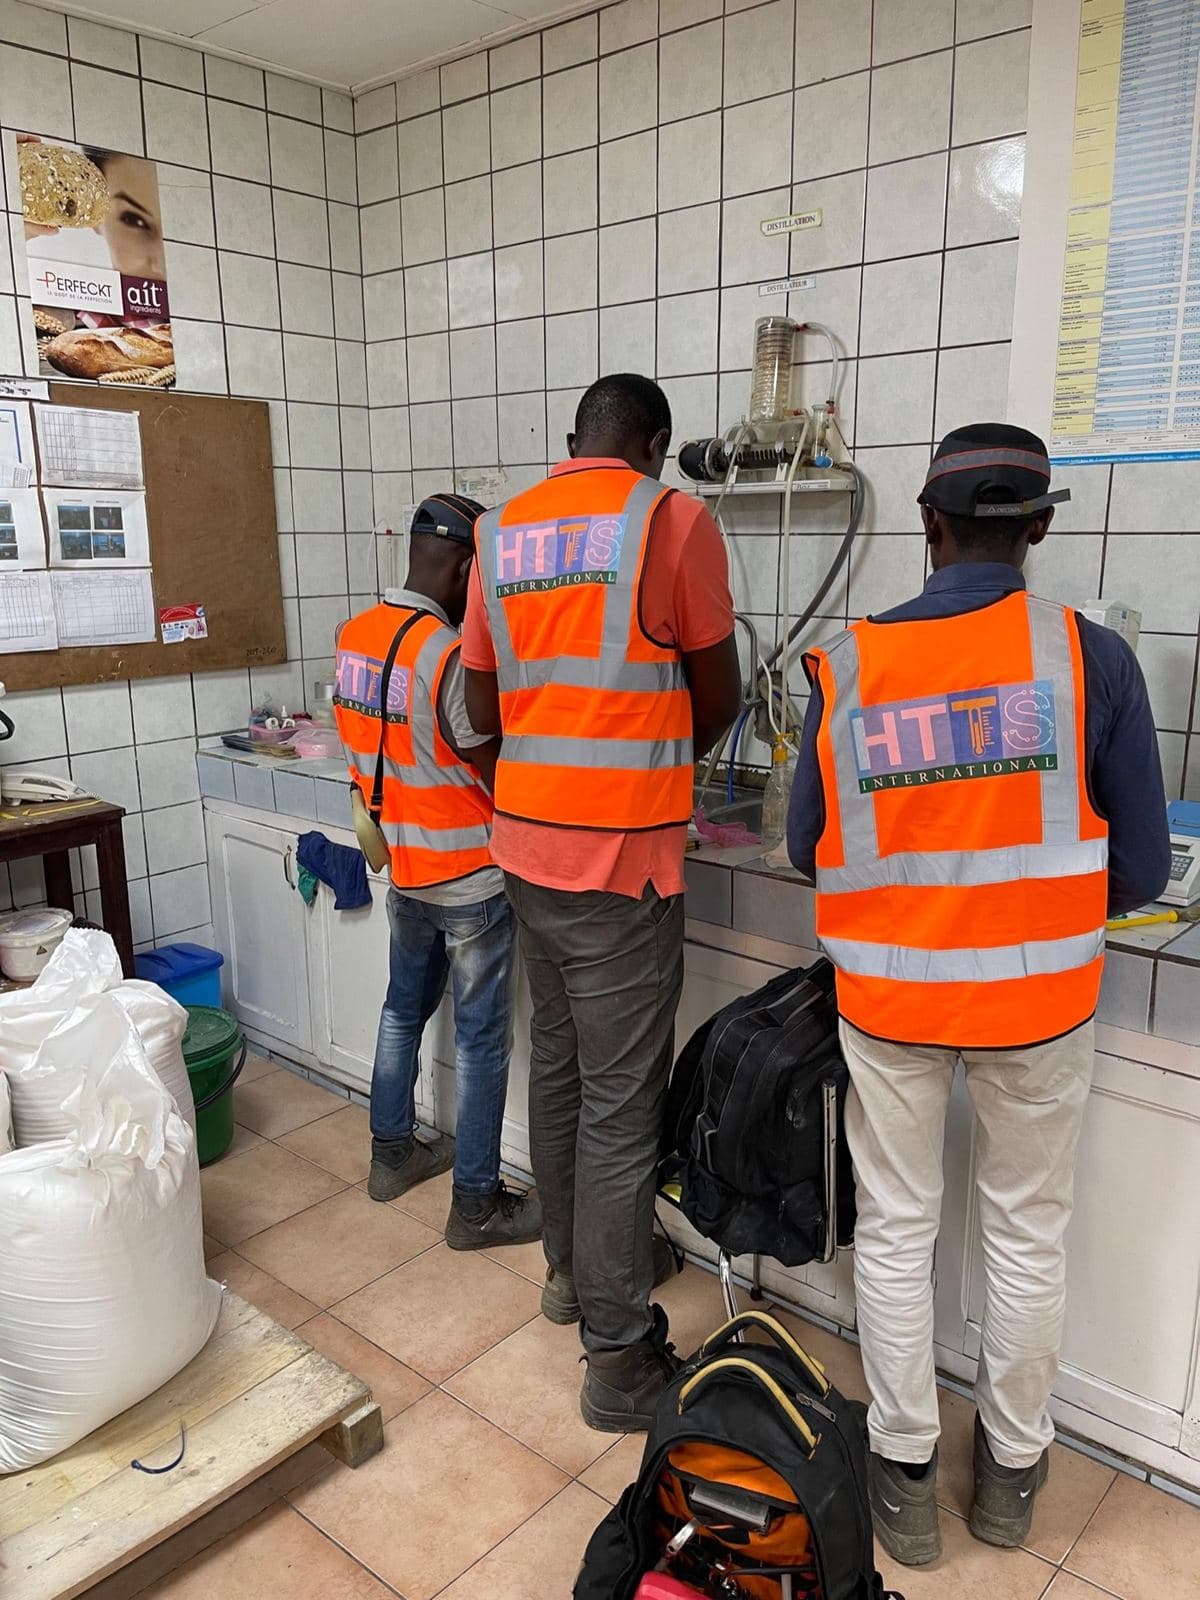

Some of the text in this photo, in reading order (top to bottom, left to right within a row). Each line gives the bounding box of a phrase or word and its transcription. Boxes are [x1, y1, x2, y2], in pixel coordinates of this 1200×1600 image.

[766, 215, 816, 232] DISTILLATION
[36, 271, 113, 298] PERFECKT
[767, 280, 807, 292] DISTILLATEUR
[495, 519, 623, 580] HTTS
[497, 573, 616, 597] INTERNATIONAL
[851, 689, 1056, 772] HTTS
[861, 756, 1056, 792] INTERNATIONAL
